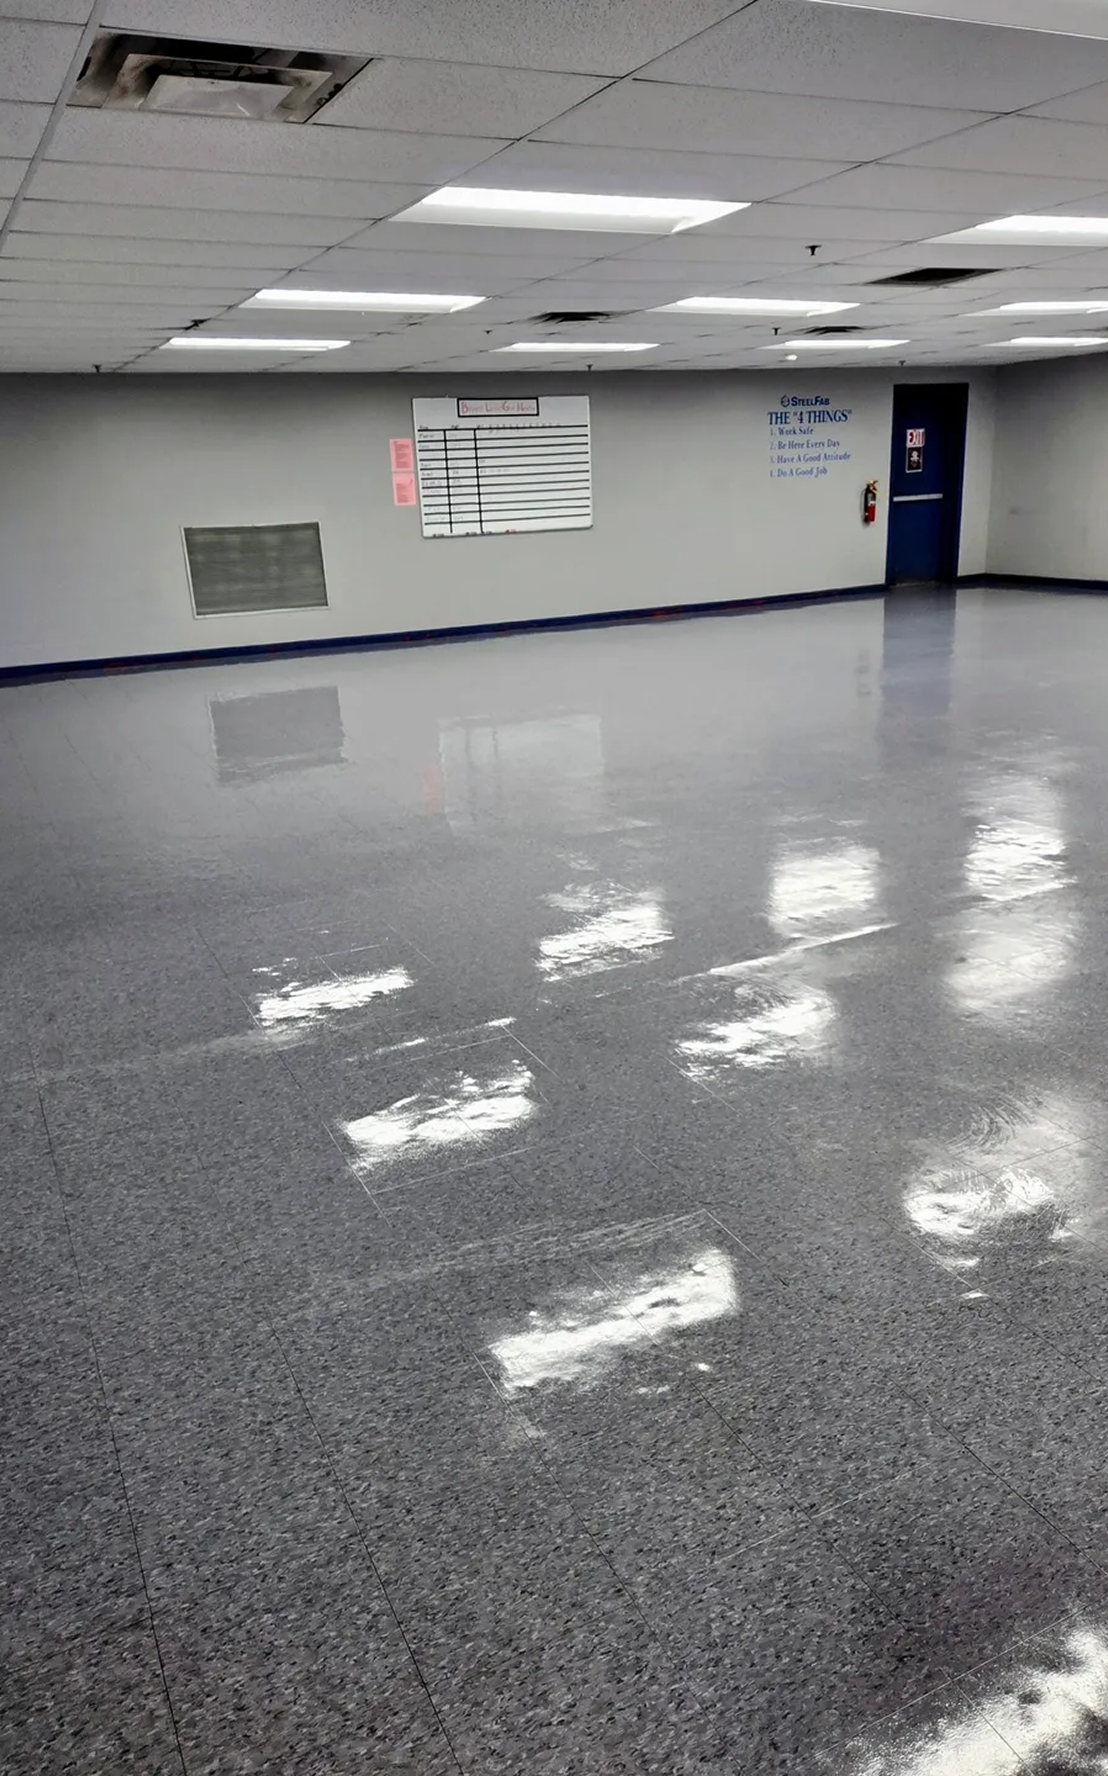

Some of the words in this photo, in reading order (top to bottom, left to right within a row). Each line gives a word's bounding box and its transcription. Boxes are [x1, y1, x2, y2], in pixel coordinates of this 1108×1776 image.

[768, 412, 791, 425] THE
[806, 410, 852, 424] THINGS"
[778, 426, 797, 436] Work
[798, 426, 814, 435] Safe
[778, 442, 786, 450] Be
[788, 440, 804, 449] Here
[806, 440, 826, 449] Every
[827, 439, 840, 449] Day
[777, 455, 794, 464] Have
[797, 454, 802, 462] A
[804, 454, 820, 462] Good
[822, 452, 850, 460] Attitude
[777, 468, 787, 477] Do
[788, 468, 794, 476] A
[796, 467, 814, 476] Good
[816, 466, 828, 478] Job
